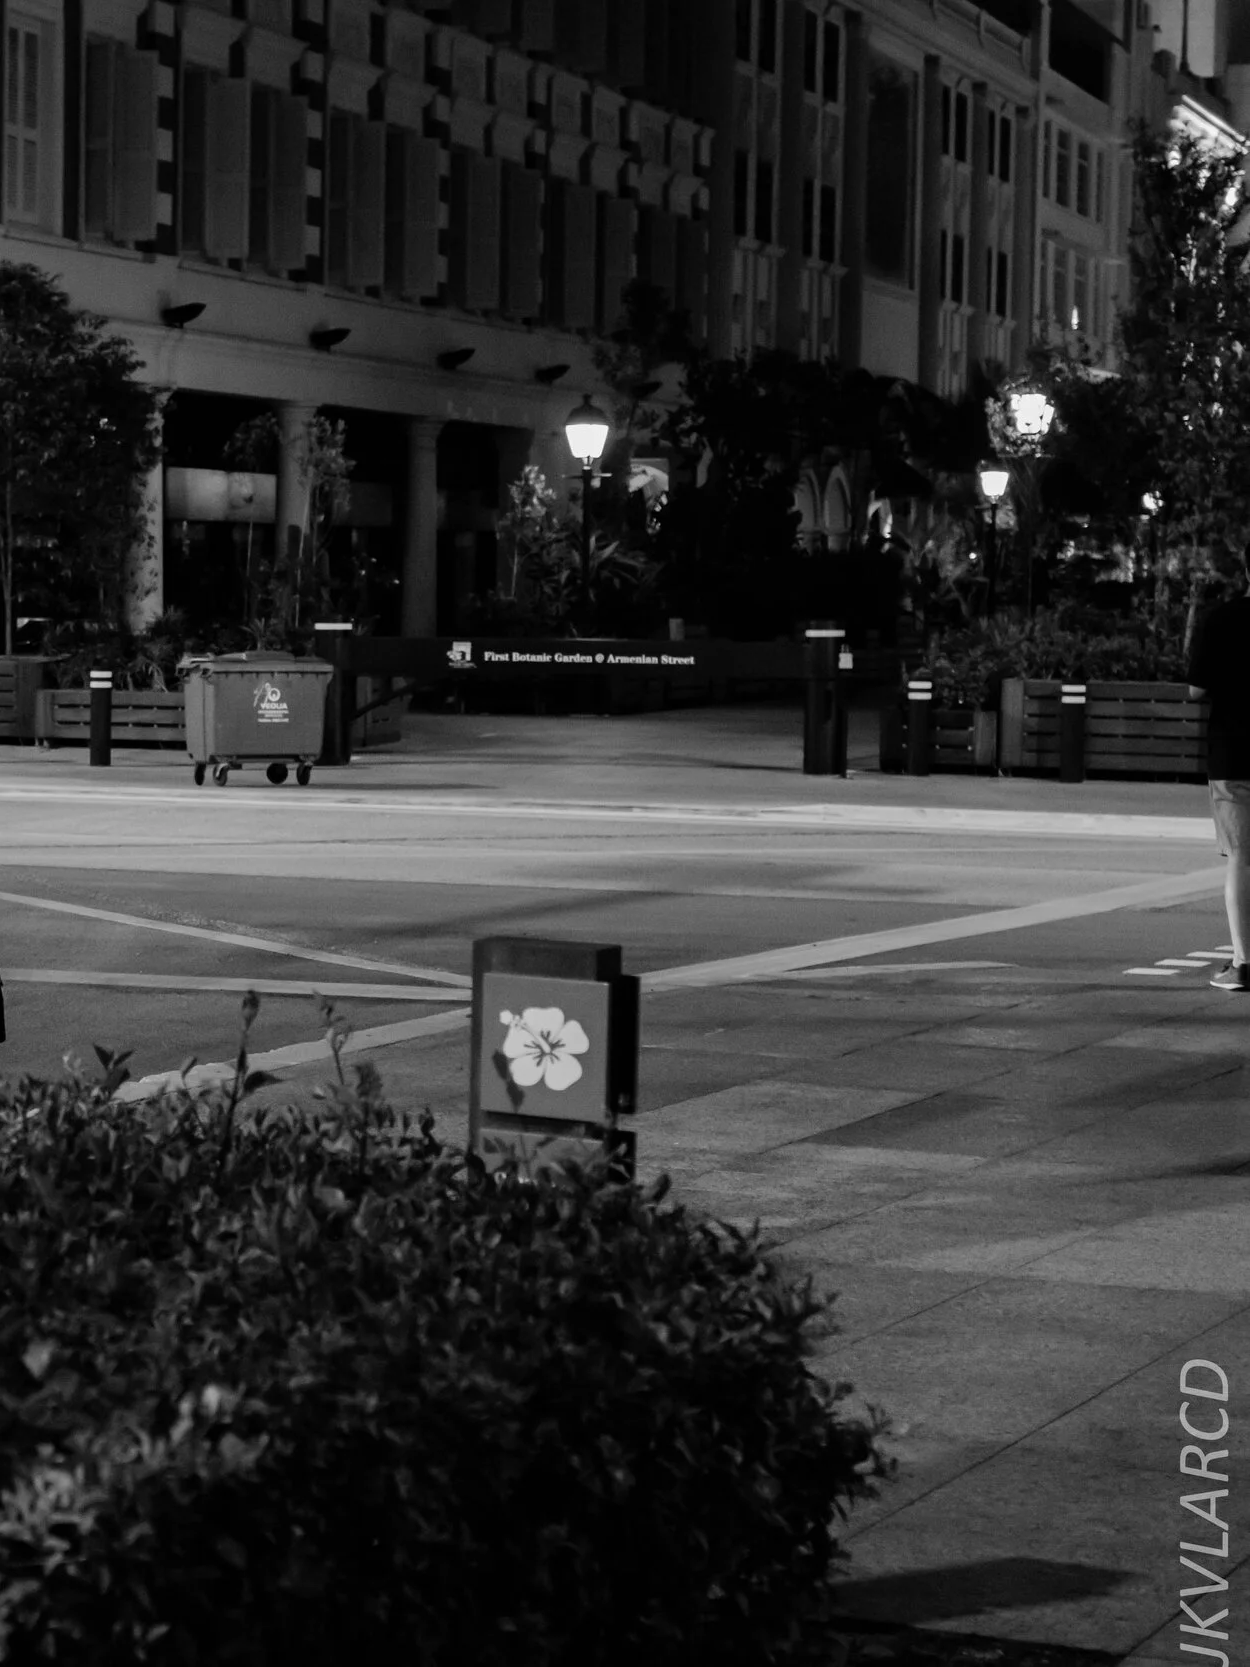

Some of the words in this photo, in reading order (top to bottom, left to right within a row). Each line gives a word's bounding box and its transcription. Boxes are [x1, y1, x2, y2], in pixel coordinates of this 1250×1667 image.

[484, 651, 510, 662] First
[511, 651, 553, 663] Botanic
[554, 652, 593, 663] Garden
[606, 653, 659, 665] Armenian
[660, 654, 696, 665] Street
